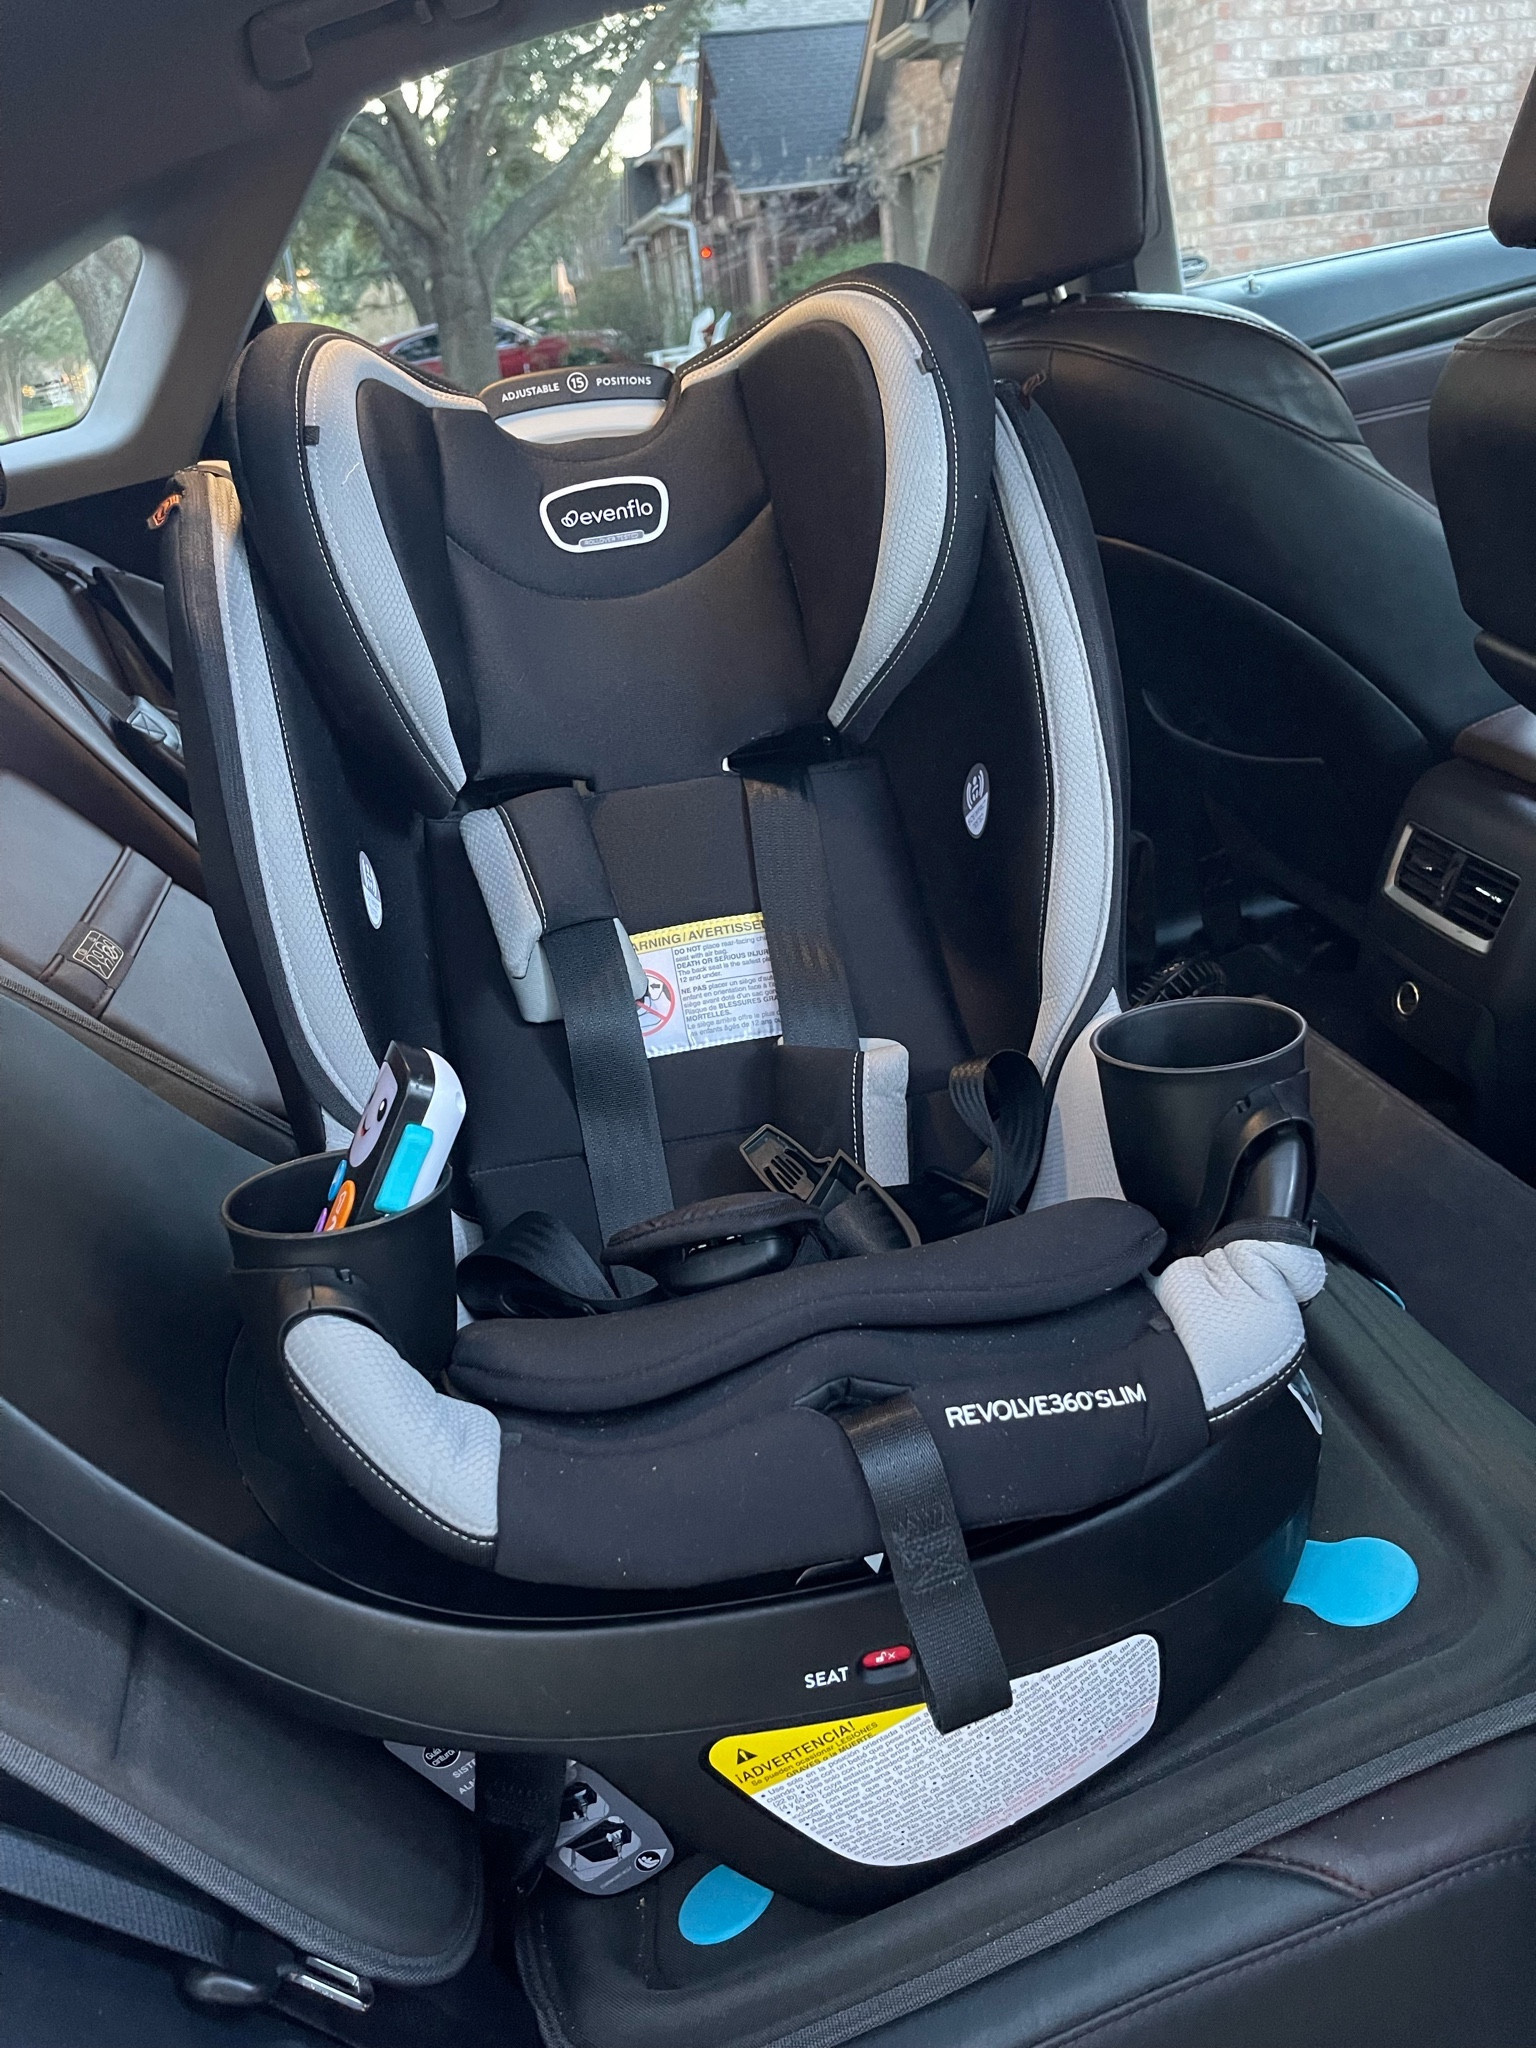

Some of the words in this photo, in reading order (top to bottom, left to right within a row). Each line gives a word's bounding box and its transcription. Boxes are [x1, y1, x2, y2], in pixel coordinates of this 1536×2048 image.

[501, 383, 560, 402] ADJUSTABLE
[571, 377, 584, 389] 15
[596, 376, 652, 387] POSITIONS
[580, 498, 654, 525] evenflo
[677, 960, 700, 969] DEATH
[715, 953, 746, 962] SERIOUS
[804, 1666, 849, 1689] SEAT
[919, 1725, 935, 1735] entr
[735, 1720, 855, 1784] ¡ADVERTENCIA!
[764, 1765, 794, 1782] pueden
[796, 1746, 833, 1766] ocasionar
[836, 1722, 877, 1747] LESIONES
[787, 1759, 821, 1778] GRAVES
